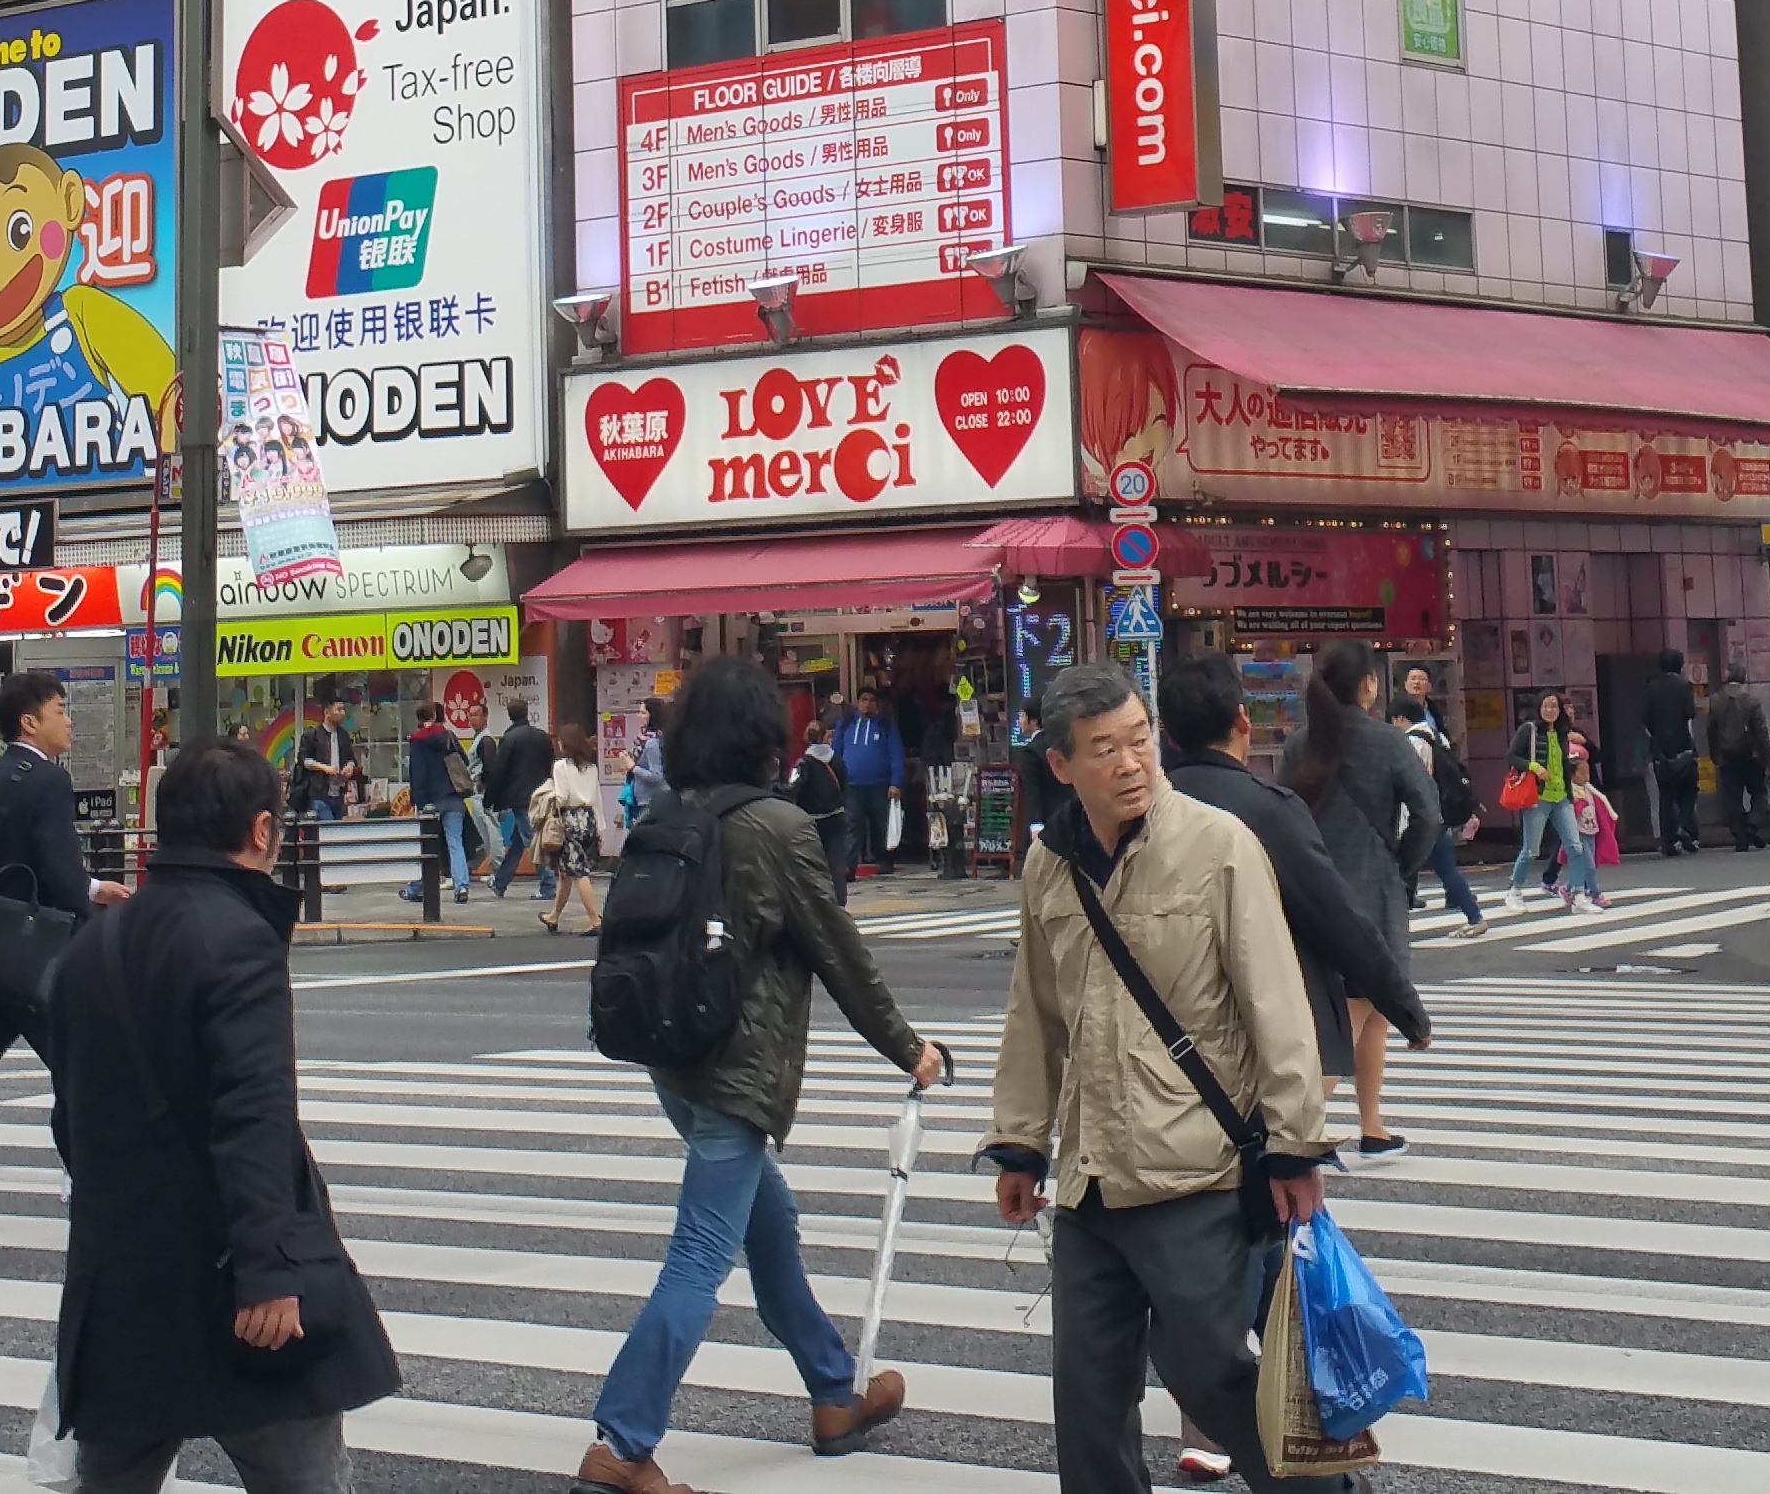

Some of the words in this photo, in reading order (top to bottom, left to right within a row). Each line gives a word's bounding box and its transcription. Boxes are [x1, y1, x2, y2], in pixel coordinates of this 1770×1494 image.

[28, 29, 61, 61] to
[382, 51, 516, 103] Tax-free
[693, 81, 758, 111] FLOOR
[761, 71, 824, 99] GUIDE
[432, 103, 516, 148] Shop
[639, 125, 668, 153] 4F
[686, 120, 737, 145] Men's
[742, 111, 804, 138] Goods
[819, 96, 889, 126] 男性用品
[955, 86, 981, 104] Only
[641, 163, 669, 192] 3F
[687, 157, 739, 183] Men's
[743, 149, 805, 175] Goods
[821, 135, 890, 165] 男性用品
[956, 127, 983, 145] Only
[642, 201, 670, 230] 2F
[688, 192, 768, 222] Couple's
[773, 183, 837, 209] Goods
[855, 171, 924, 200] 女士用品
[967, 166, 987, 183] OK
[318, 199, 428, 241] UnionPay
[644, 239, 671, 268] 1F
[689, 233, 774, 260] Costume
[779, 221, 858, 255] Lingerie
[871, 210, 924, 238] 変身服
[969, 206, 988, 222] OK
[359, 236, 417, 272] 银联
[645, 278, 671, 306] B1
[689, 271, 746, 298] Fetish
[719, 364, 893, 442] LOVE
[959, 389, 989, 409] OPEN
[994, 384, 1031, 405] 10:00
[599, 409, 670, 446] 秋葉原
[954, 410, 989, 432] CLOSE
[995, 407, 1032, 427] 22:00
[602, 444, 666, 462] AKIHABARA
[1118, 472, 1147, 496] 20
[336, 566, 453, 599] SPECTRUM
[217, 633, 292, 666] Nikon
[301, 632, 385, 660] Canon
[392, 618, 511, 662] ONODEN
[499, 672, 540, 691] Japan.
